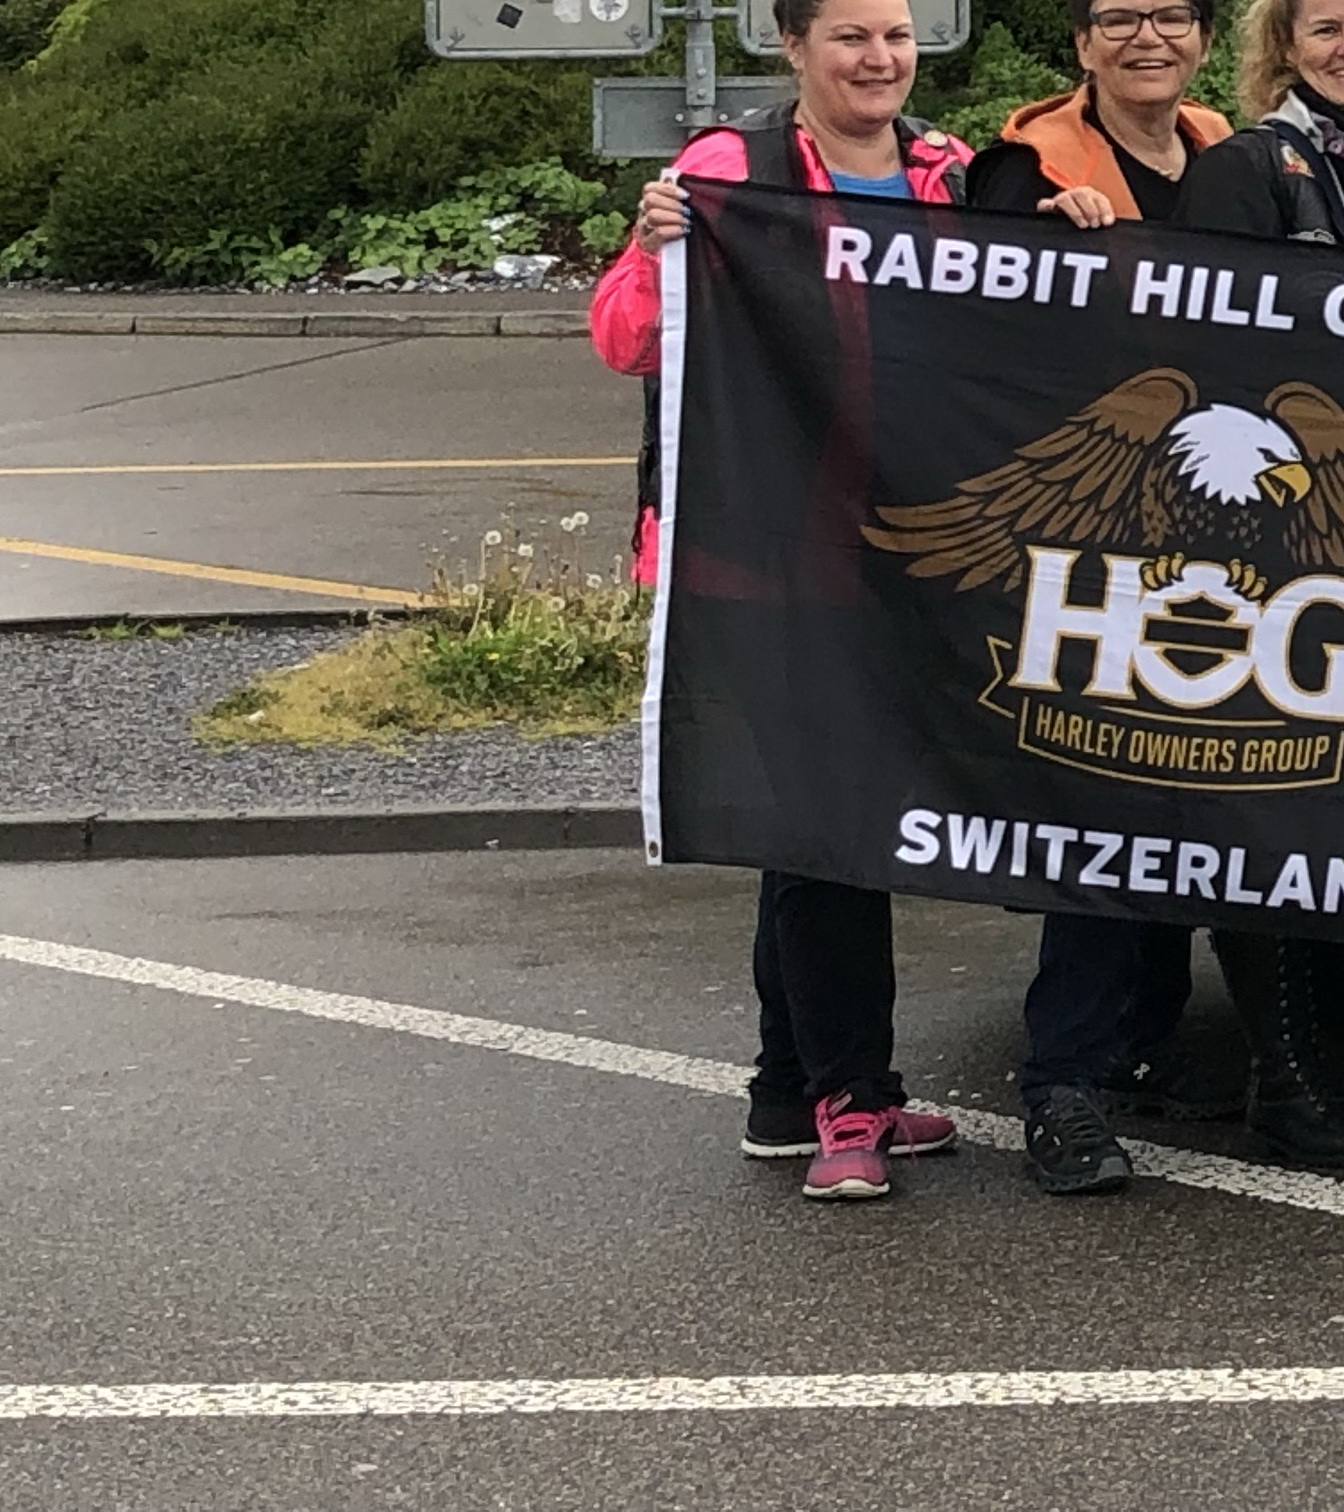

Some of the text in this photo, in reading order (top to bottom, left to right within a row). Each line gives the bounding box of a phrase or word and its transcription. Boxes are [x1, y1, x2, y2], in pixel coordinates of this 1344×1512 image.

[824, 226, 1108, 308] RABBIT
[1131, 260, 1294, 330] HILL
[1035, 704, 1331, 773] HARLEY OWNERS GROUP
